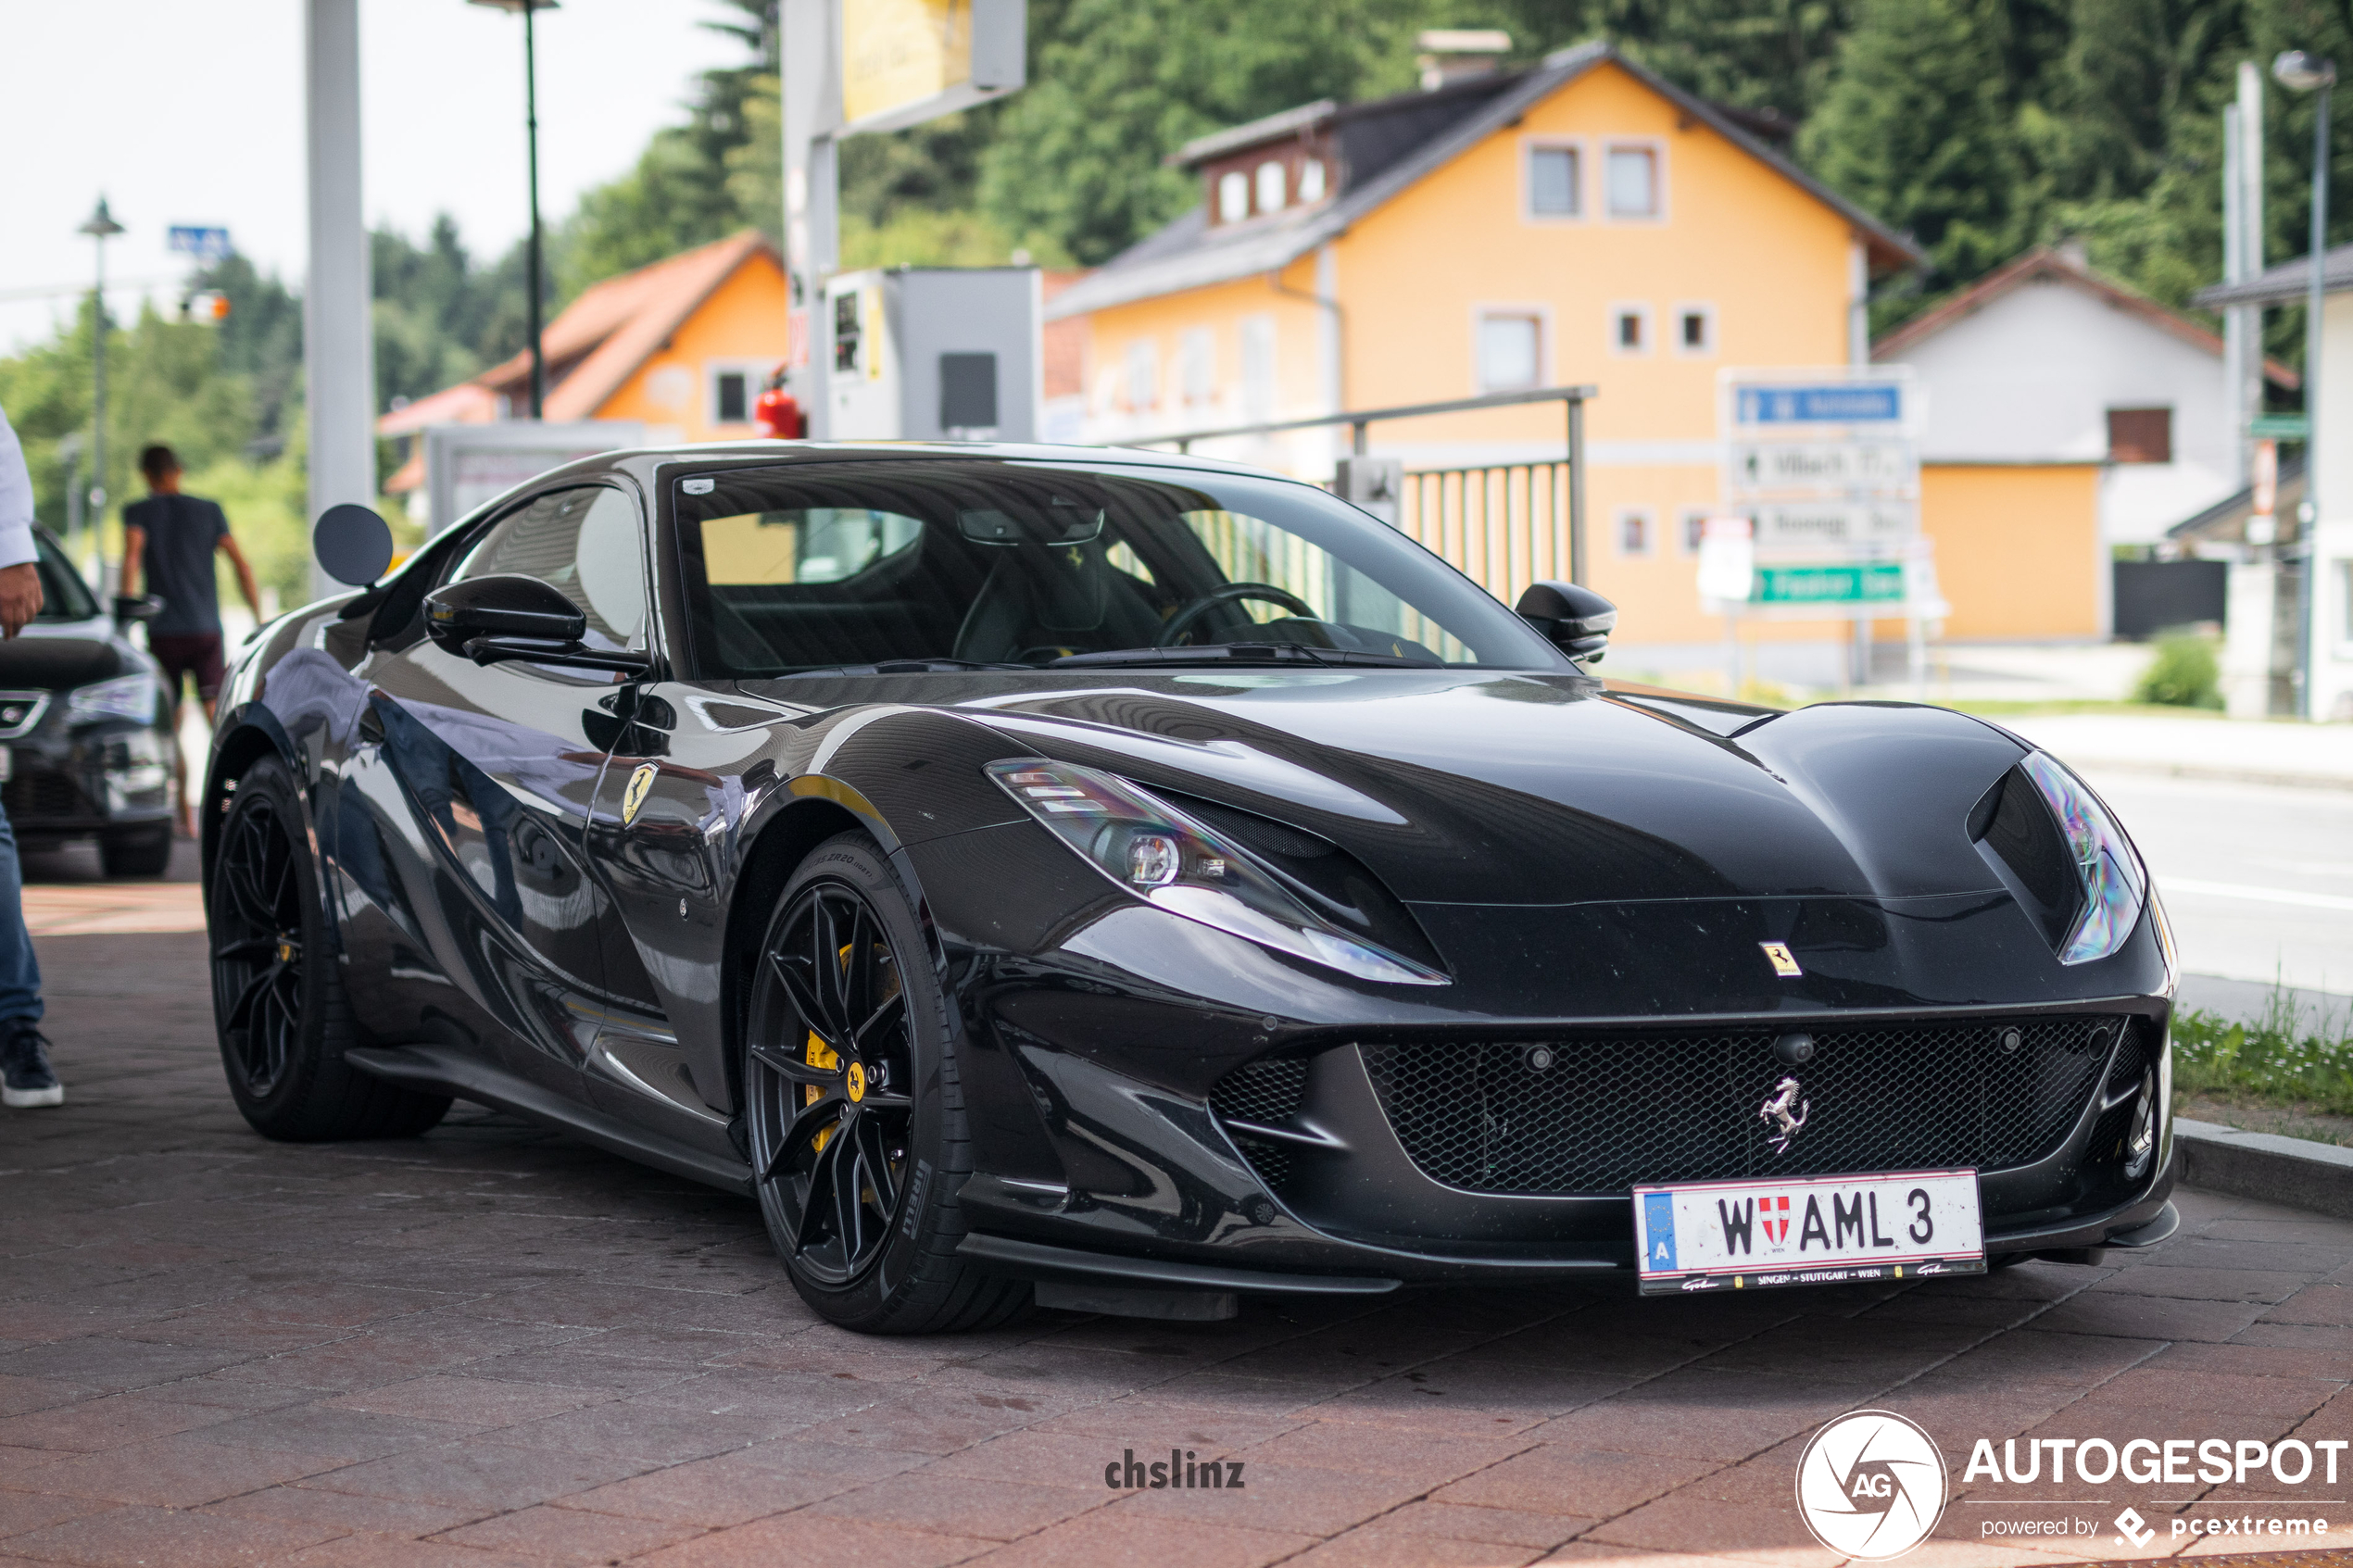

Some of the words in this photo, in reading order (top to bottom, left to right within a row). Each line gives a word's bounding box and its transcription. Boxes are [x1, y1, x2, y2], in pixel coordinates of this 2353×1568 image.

[902, 1159, 932, 1240] PIRELLI
[1718, 1197, 1753, 1256] W
[1800, 1191, 1894, 1251] AML
[1907, 1187, 1933, 1245] 3
[1655, 1241, 1669, 1261] A
[1757, 1273, 1791, 1286] SINGEN
[1800, 1270, 1848, 1283] STUTTGART
[1858, 1268, 1881, 1279] WIEN
